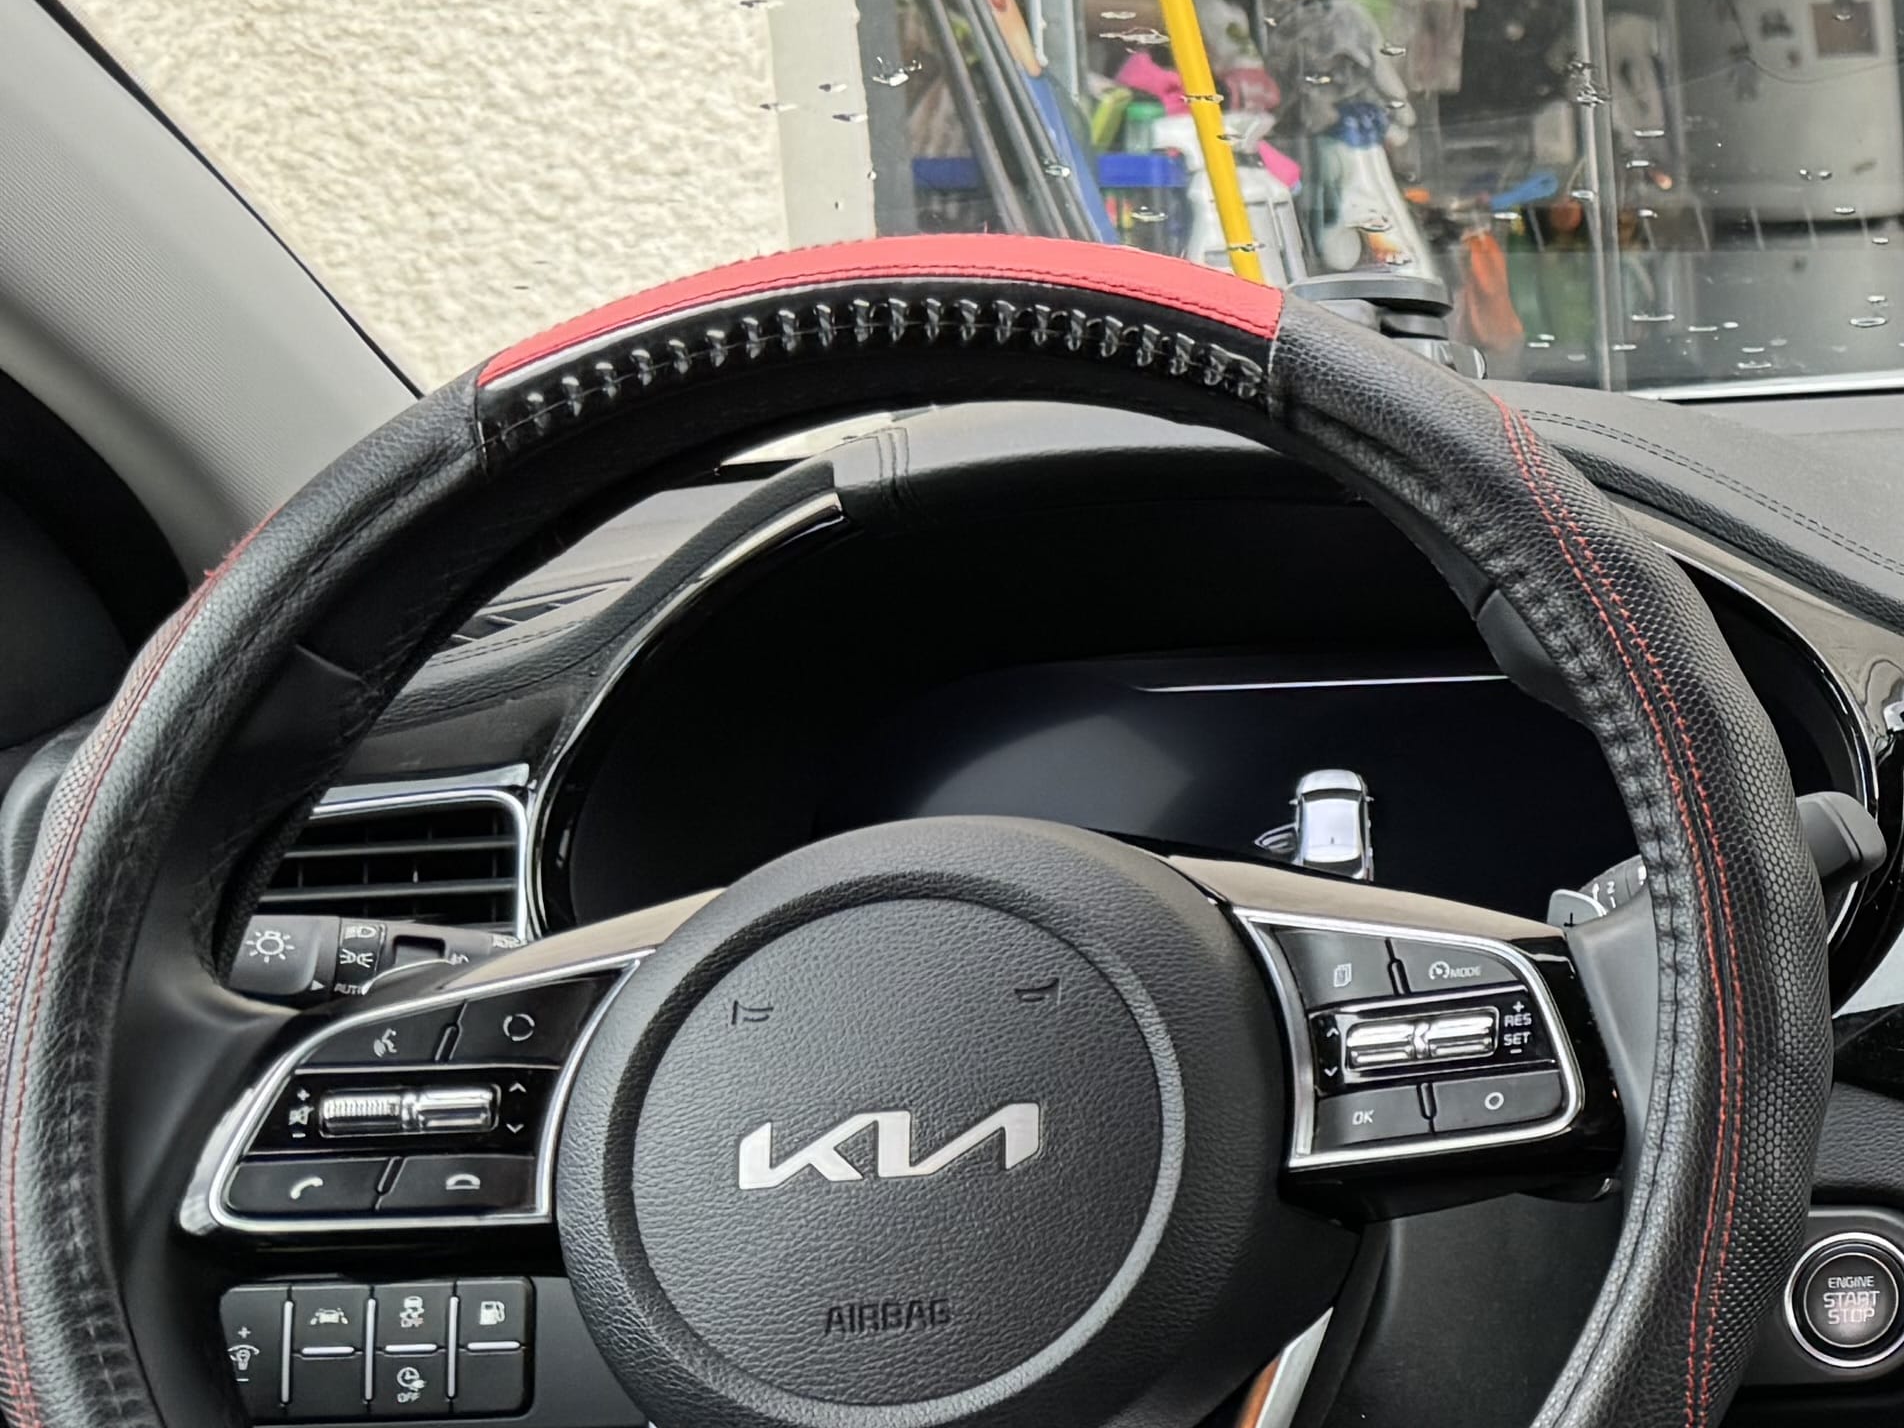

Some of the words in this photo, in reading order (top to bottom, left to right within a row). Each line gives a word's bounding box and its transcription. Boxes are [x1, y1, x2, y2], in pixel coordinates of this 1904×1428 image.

[1503, 1012, 1533, 1028] RES
[1503, 1031, 1531, 1047] SET
[1352, 1109, 1375, 1126] OK
[1827, 1275, 1875, 1289] ENGINE
[1823, 1290, 1880, 1309] START
[824, 1298, 951, 1334] AIRBAG
[1827, 1308, 1876, 1325] STOP
[397, 1391, 420, 1404] OFF
